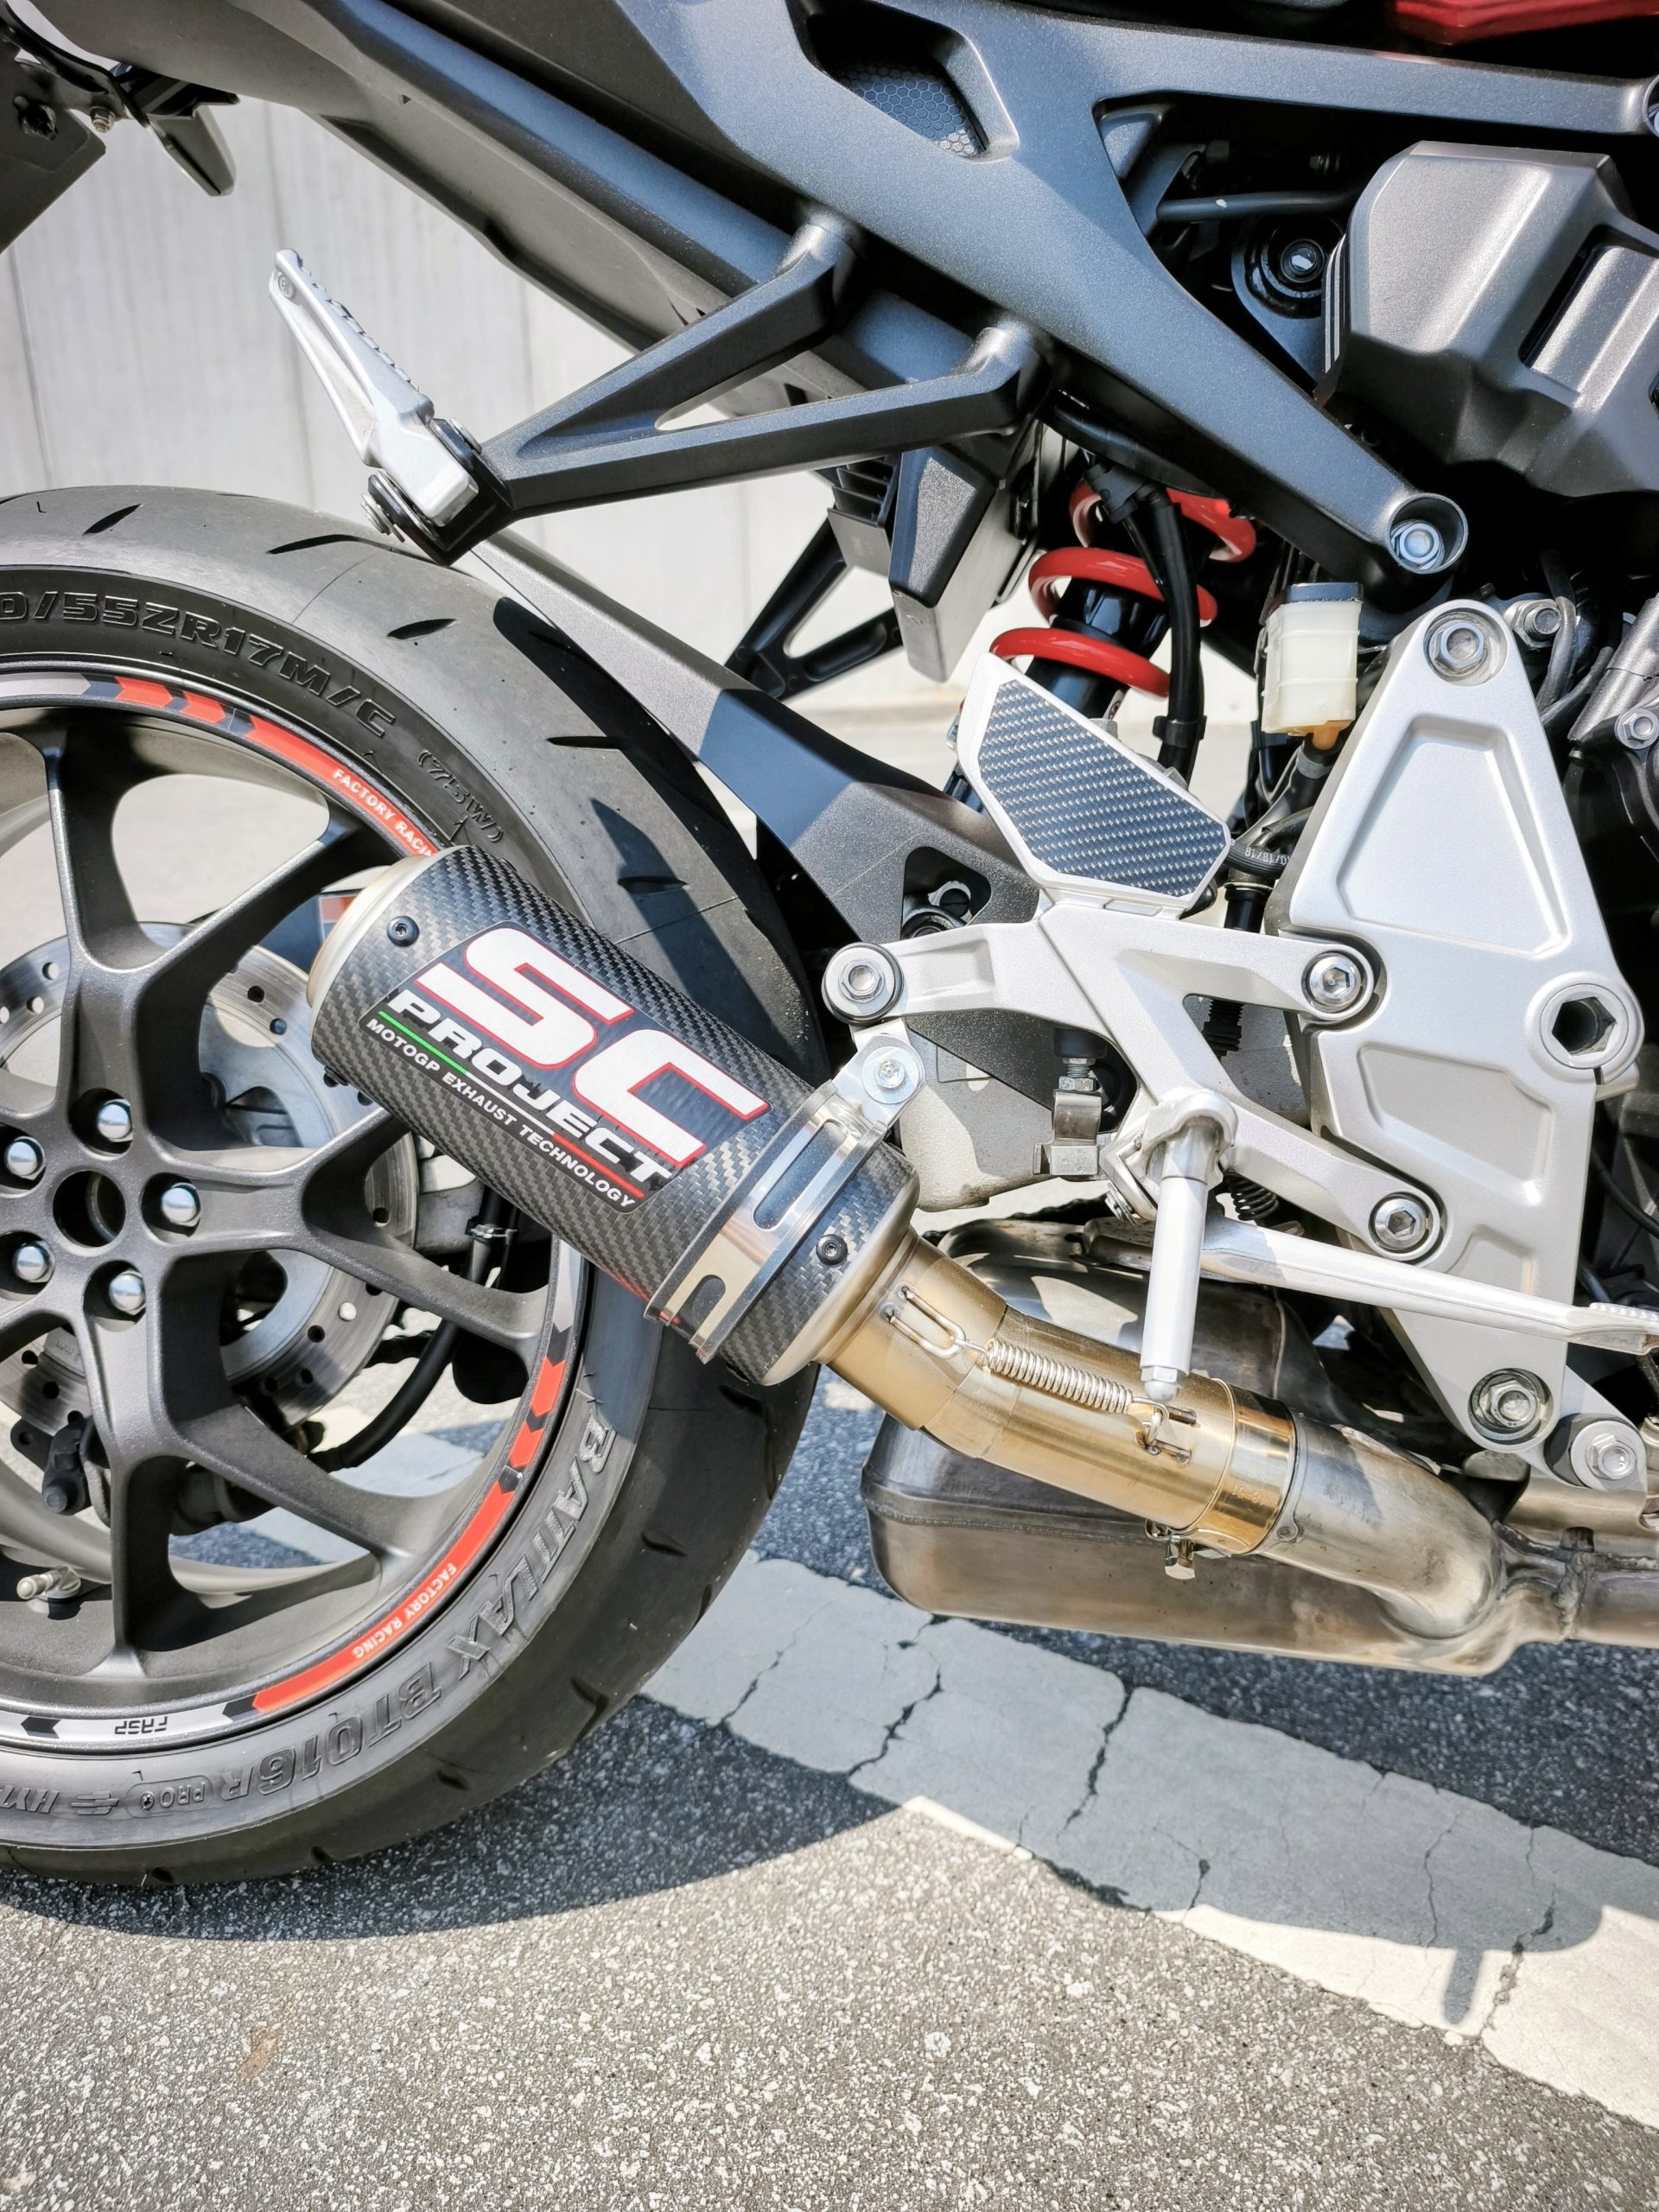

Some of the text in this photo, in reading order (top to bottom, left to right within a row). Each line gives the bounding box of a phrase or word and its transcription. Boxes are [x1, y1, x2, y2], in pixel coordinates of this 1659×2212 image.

[333, 768, 396, 821] FACTORY
[366, 1018, 636, 1208] MOTOGP EXHAUST TECHNOLOGY
[387, 988, 673, 1183] PROJECT
[415, 927, 769, 1168] SC
[352, 1562, 457, 1658] FACTORY RACING
[114, 1716, 168, 1734] FASP
